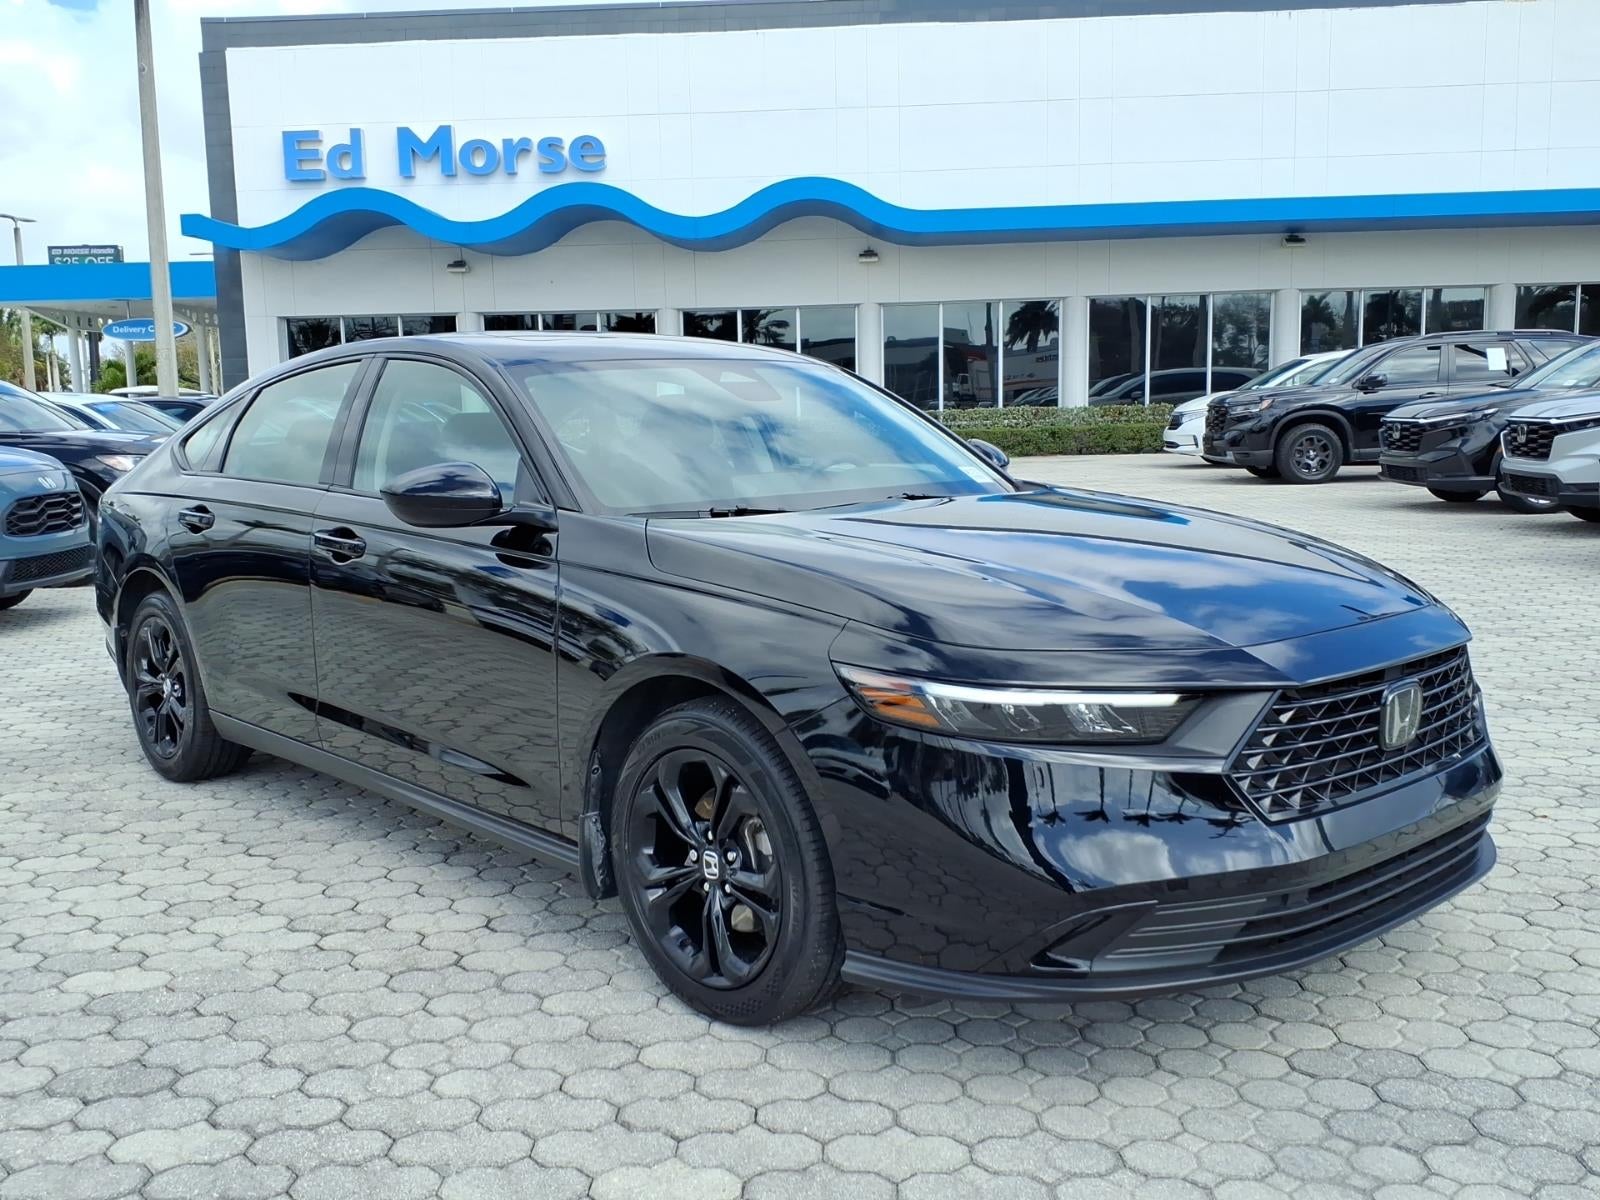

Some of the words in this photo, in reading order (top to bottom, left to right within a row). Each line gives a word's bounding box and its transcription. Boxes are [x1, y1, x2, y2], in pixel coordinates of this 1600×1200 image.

[282, 127, 366, 182] Ed
[396, 125, 607, 178] Morse
[112, 325, 146, 334] Delivery
